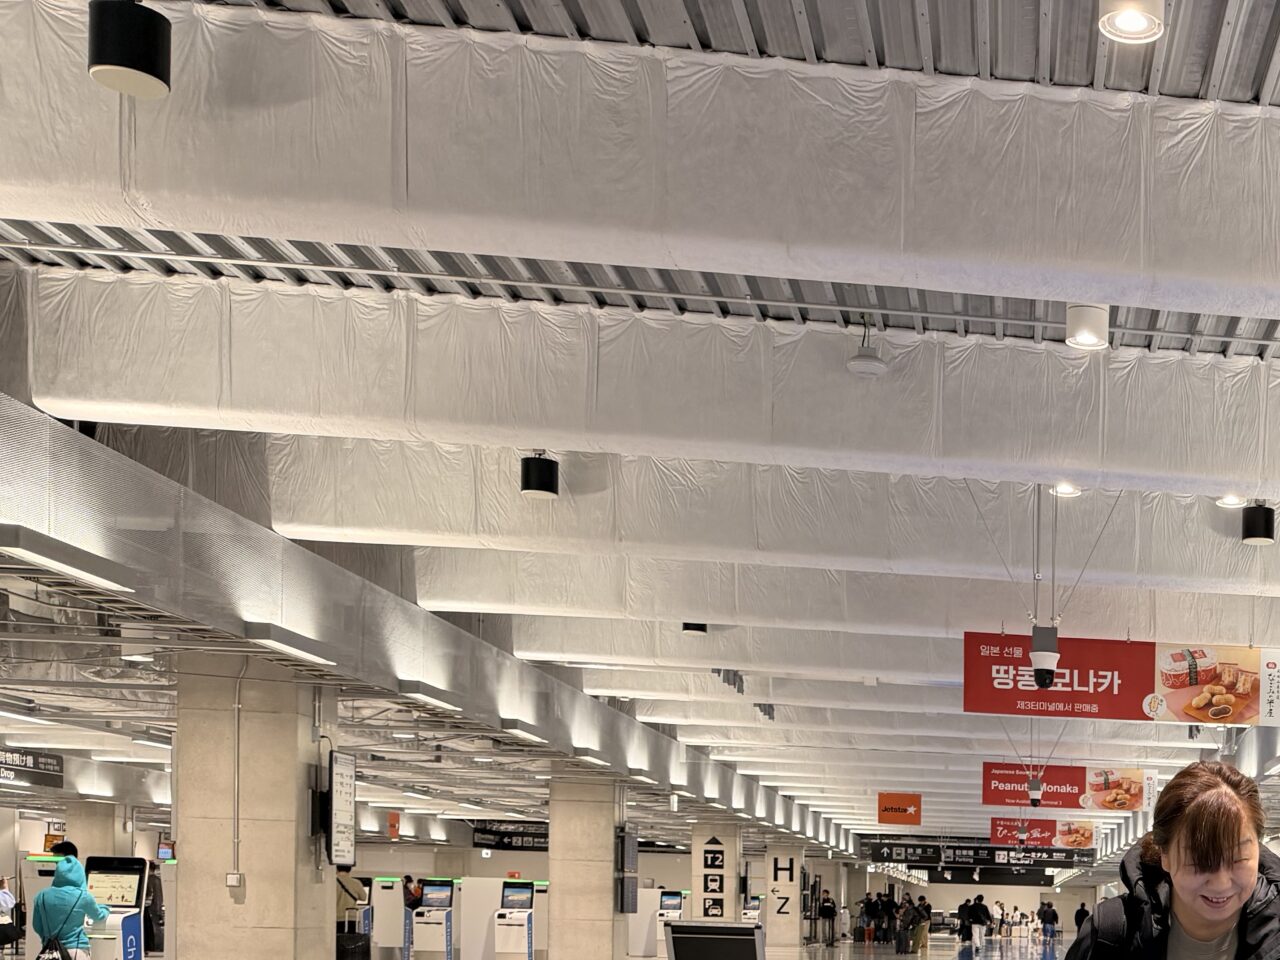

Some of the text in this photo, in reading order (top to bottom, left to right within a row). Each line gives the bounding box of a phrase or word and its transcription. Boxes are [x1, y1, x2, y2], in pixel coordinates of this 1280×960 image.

[980, 645, 1023, 658] 일본 선물
[992, 665, 1122, 694] 땅콩 모나카
[1016, 700, 1099, 713] 제3터미널에서 판매중
[1, 768, 15, 780] Drop
[991, 780, 1029, 791] Peanut
[705, 854, 723, 866] T2
[773, 857, 794, 882] H
[705, 900, 713, 908] P
[776, 897, 790, 914] Z
